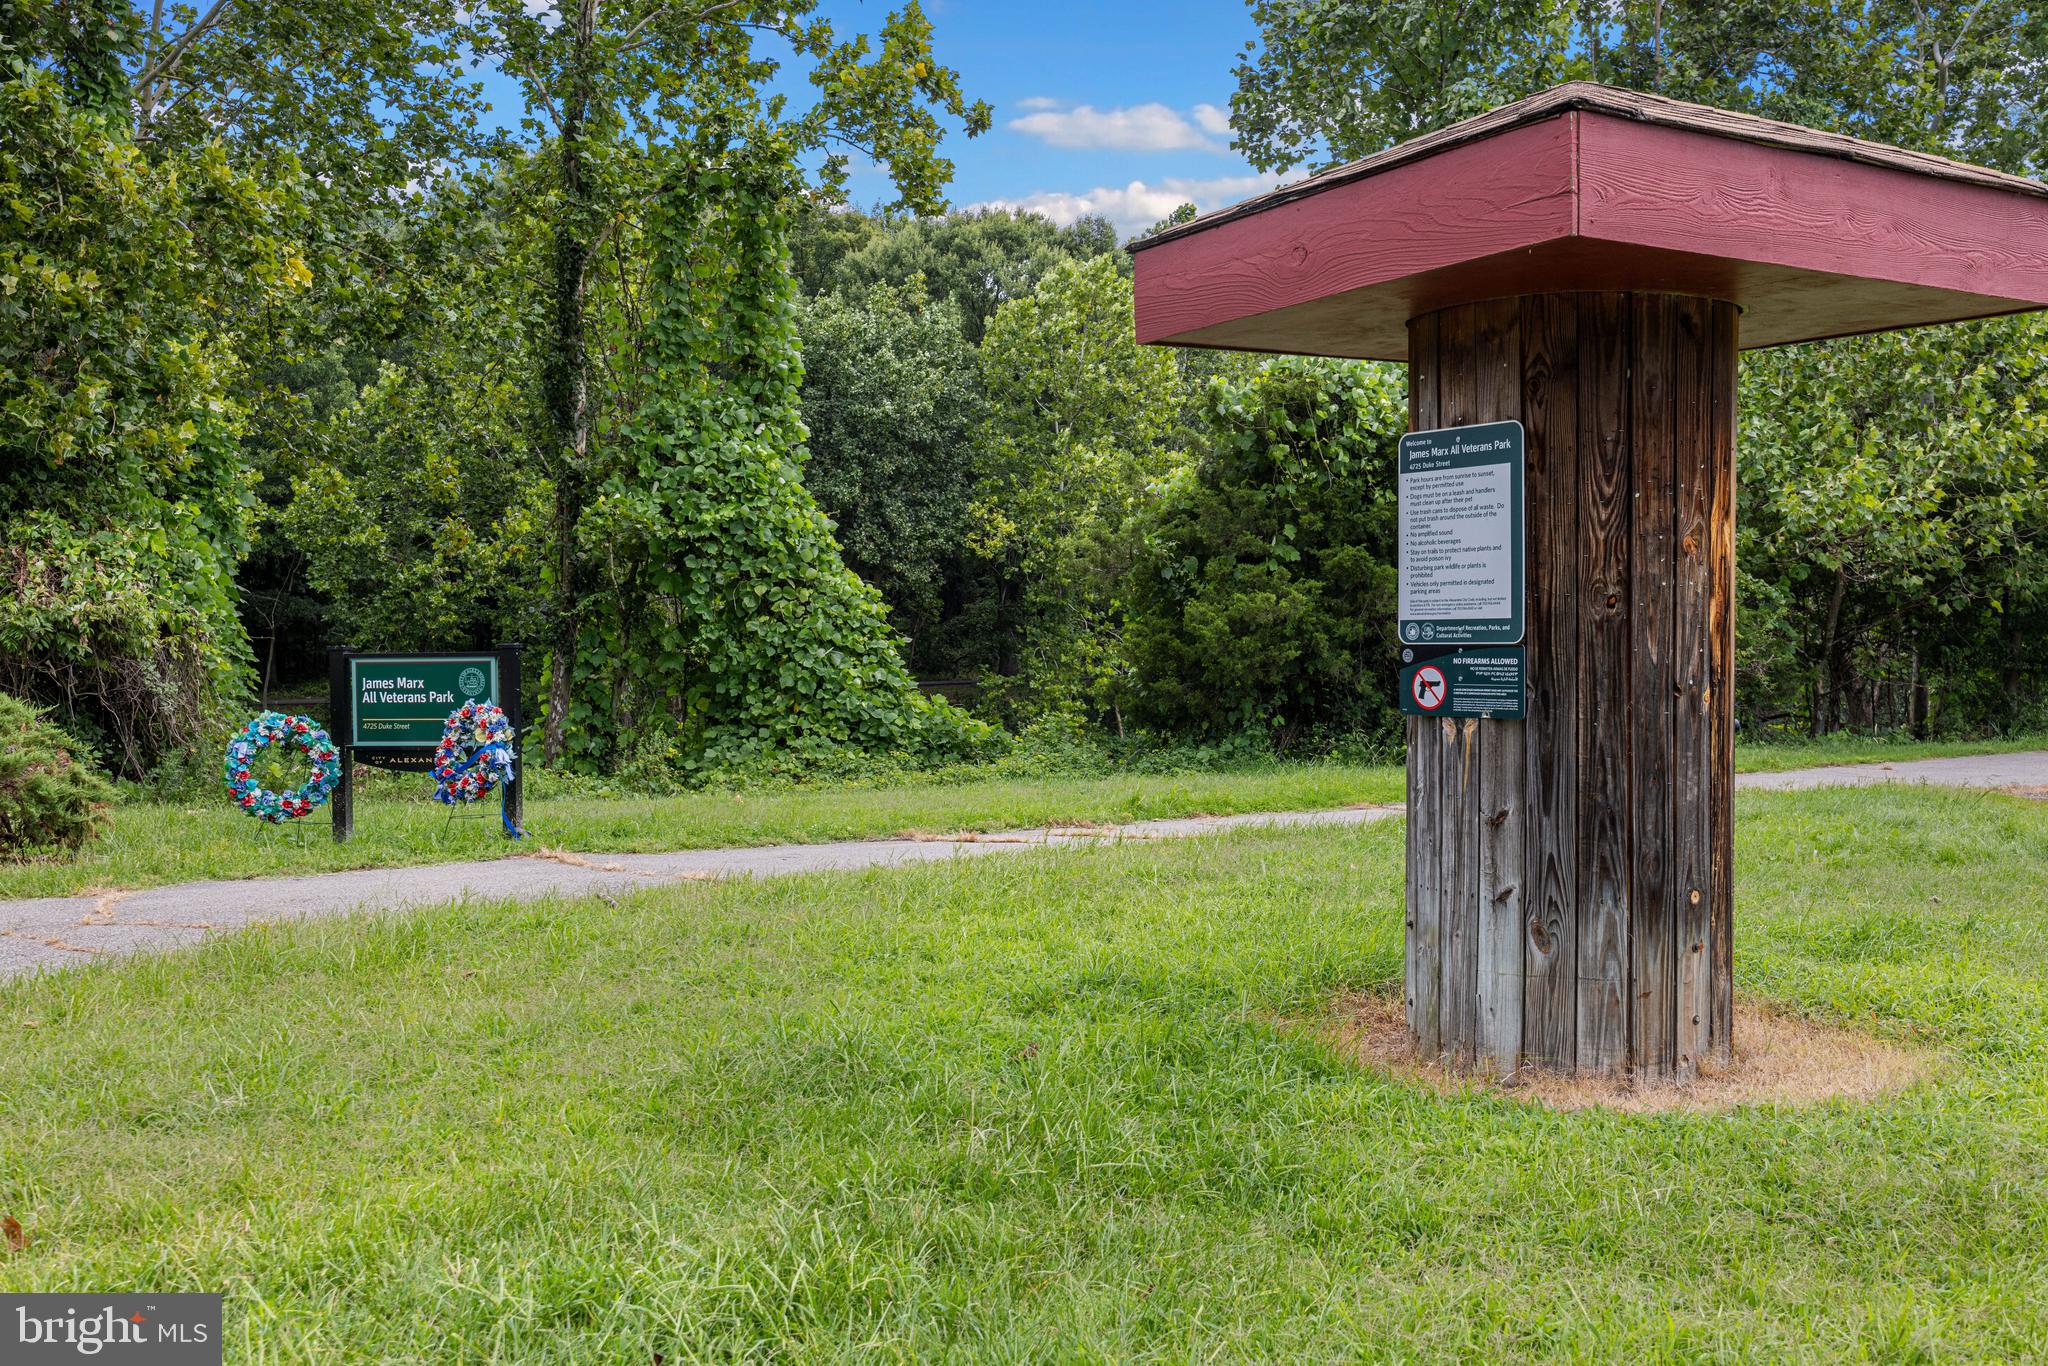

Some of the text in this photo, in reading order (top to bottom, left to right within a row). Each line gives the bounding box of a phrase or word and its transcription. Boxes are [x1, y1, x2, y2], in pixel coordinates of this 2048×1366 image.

[1409, 438, 1511, 460] James Marx All Veterans Park
[1440, 578, 1462, 586] permitted
[362, 677, 424, 690] James Marx
[362, 691, 454, 703] All Veterans Park
